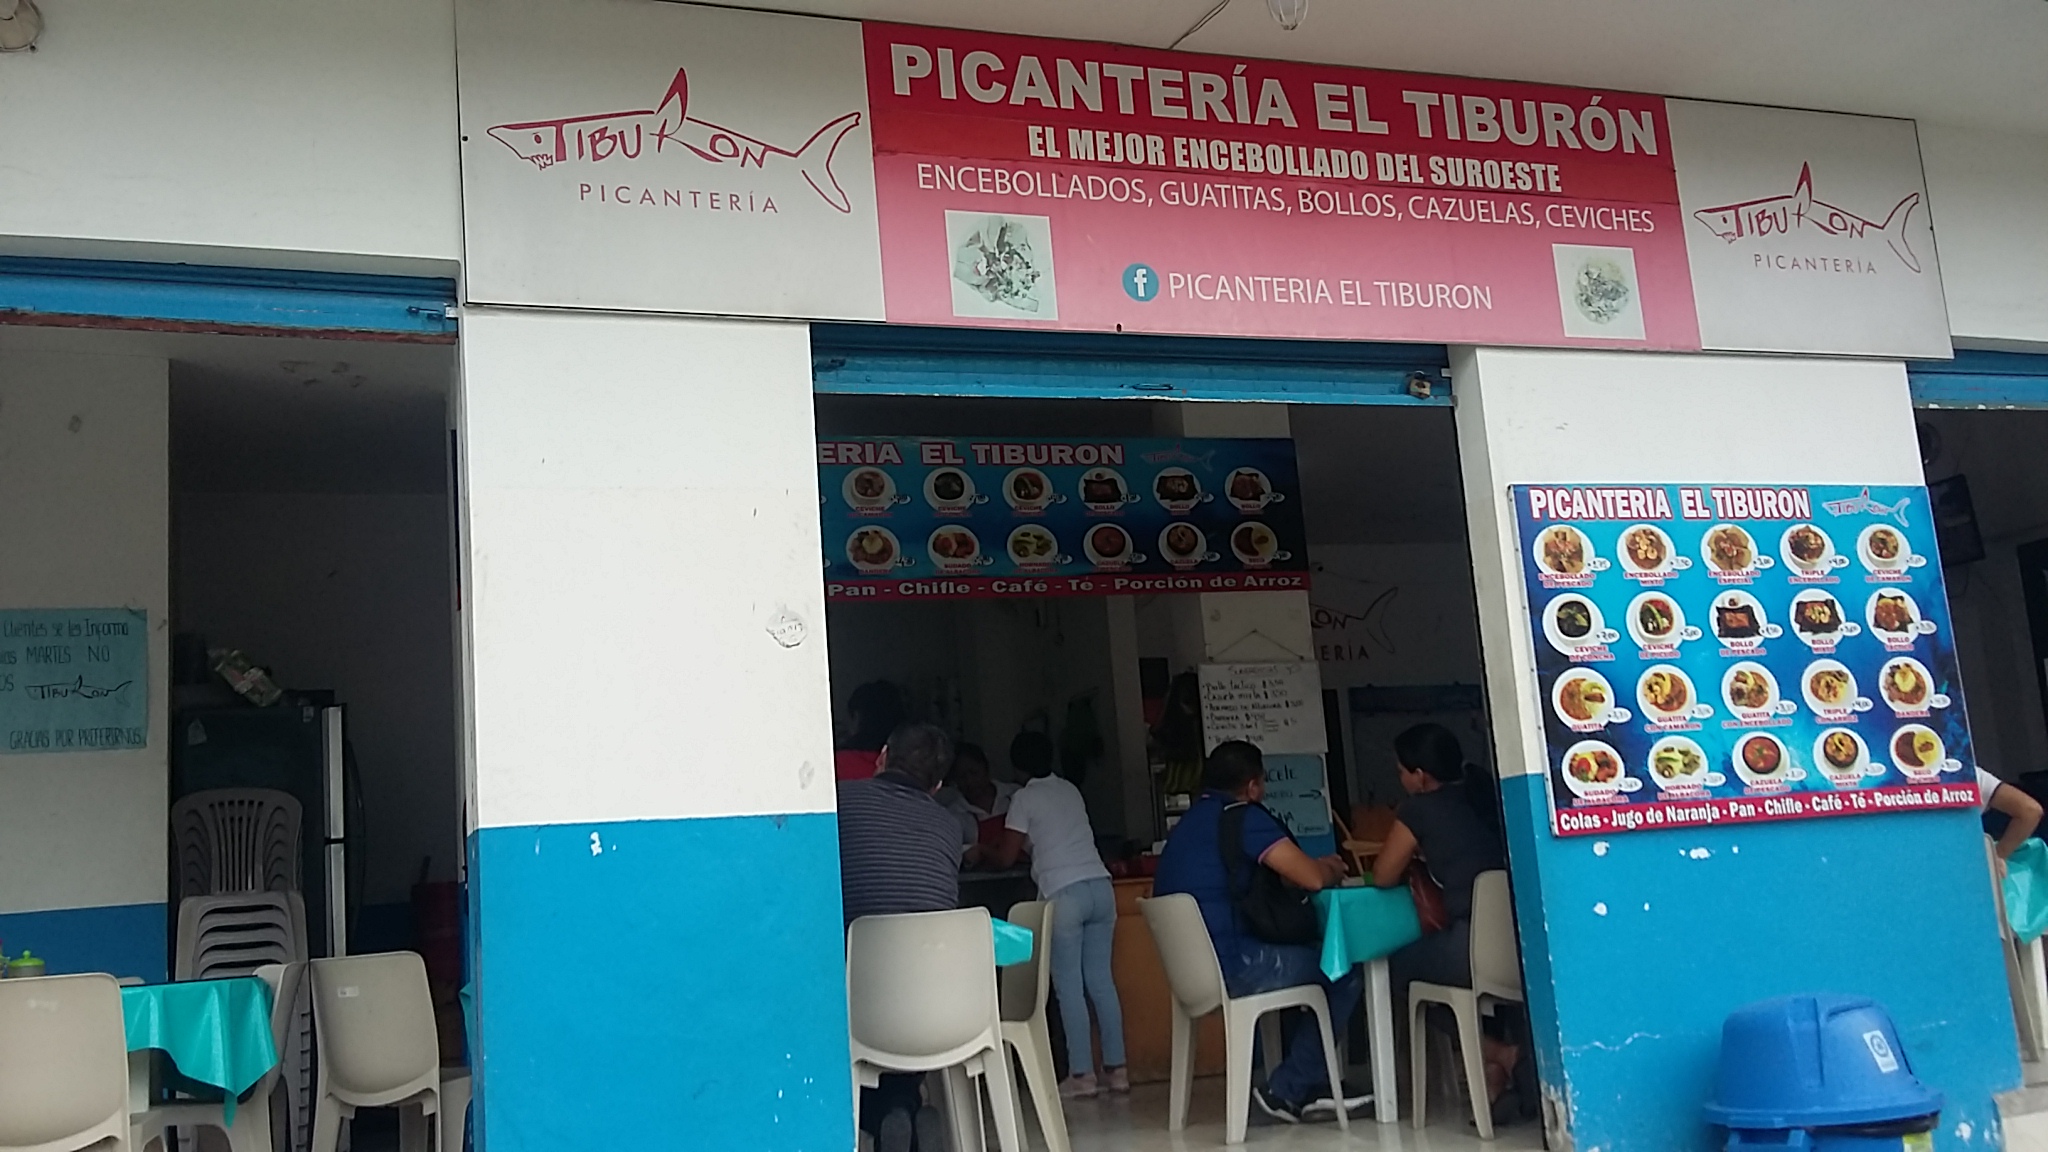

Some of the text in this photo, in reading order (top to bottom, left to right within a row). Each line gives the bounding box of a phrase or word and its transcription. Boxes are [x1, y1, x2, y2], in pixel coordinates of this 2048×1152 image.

[890, 43, 1659, 155] PICANTERÍA EL TIBURÓN
[1027, 125, 1562, 193] EL MEJOR ENCEBOLLADO DEL SUROESTE
[579, 182, 779, 214] PICANTERÍA
[917, 163, 1655, 233] ENCEBOLLADOS, GUATITAS, BOLLOS, CAZUELAS, CEVICHES
[1753, 252, 1878, 275] PICANTERÍA
[1168, 272, 1492, 310] PICANTERIA EL TIBURON
[920, 443, 966, 466] EL
[971, 443, 1125, 467] TIBURON
[1529, 488, 1812, 520] PICANTERIA EL TIBURON
[827, 583, 877, 598] Pan
[899, 580, 971, 596] Chifle
[992, 578, 1048, 594] Café
[1068, 576, 1095, 592] Té
[1114, 576, 1202, 590] Porción
[1210, 576, 1237, 588] de
[1244, 575, 1302, 588] Arroz
[88, 645, 110, 662] NO
[1560, 812, 1601, 831] Colas
[1611, 809, 1643, 829] Jugo
[1646, 807, 1664, 823] de
[1665, 803, 1720, 824] Naranja
[1729, 802, 1755, 818] Pan
[1764, 797, 1801, 815] Chifle
[1811, 794, 1842, 811] Café
[1850, 791, 1866, 809] Té
[1874, 789, 1922, 807] Porción
[1924, 788, 1938, 804] de
[1941, 786, 1974, 803] Arroz
